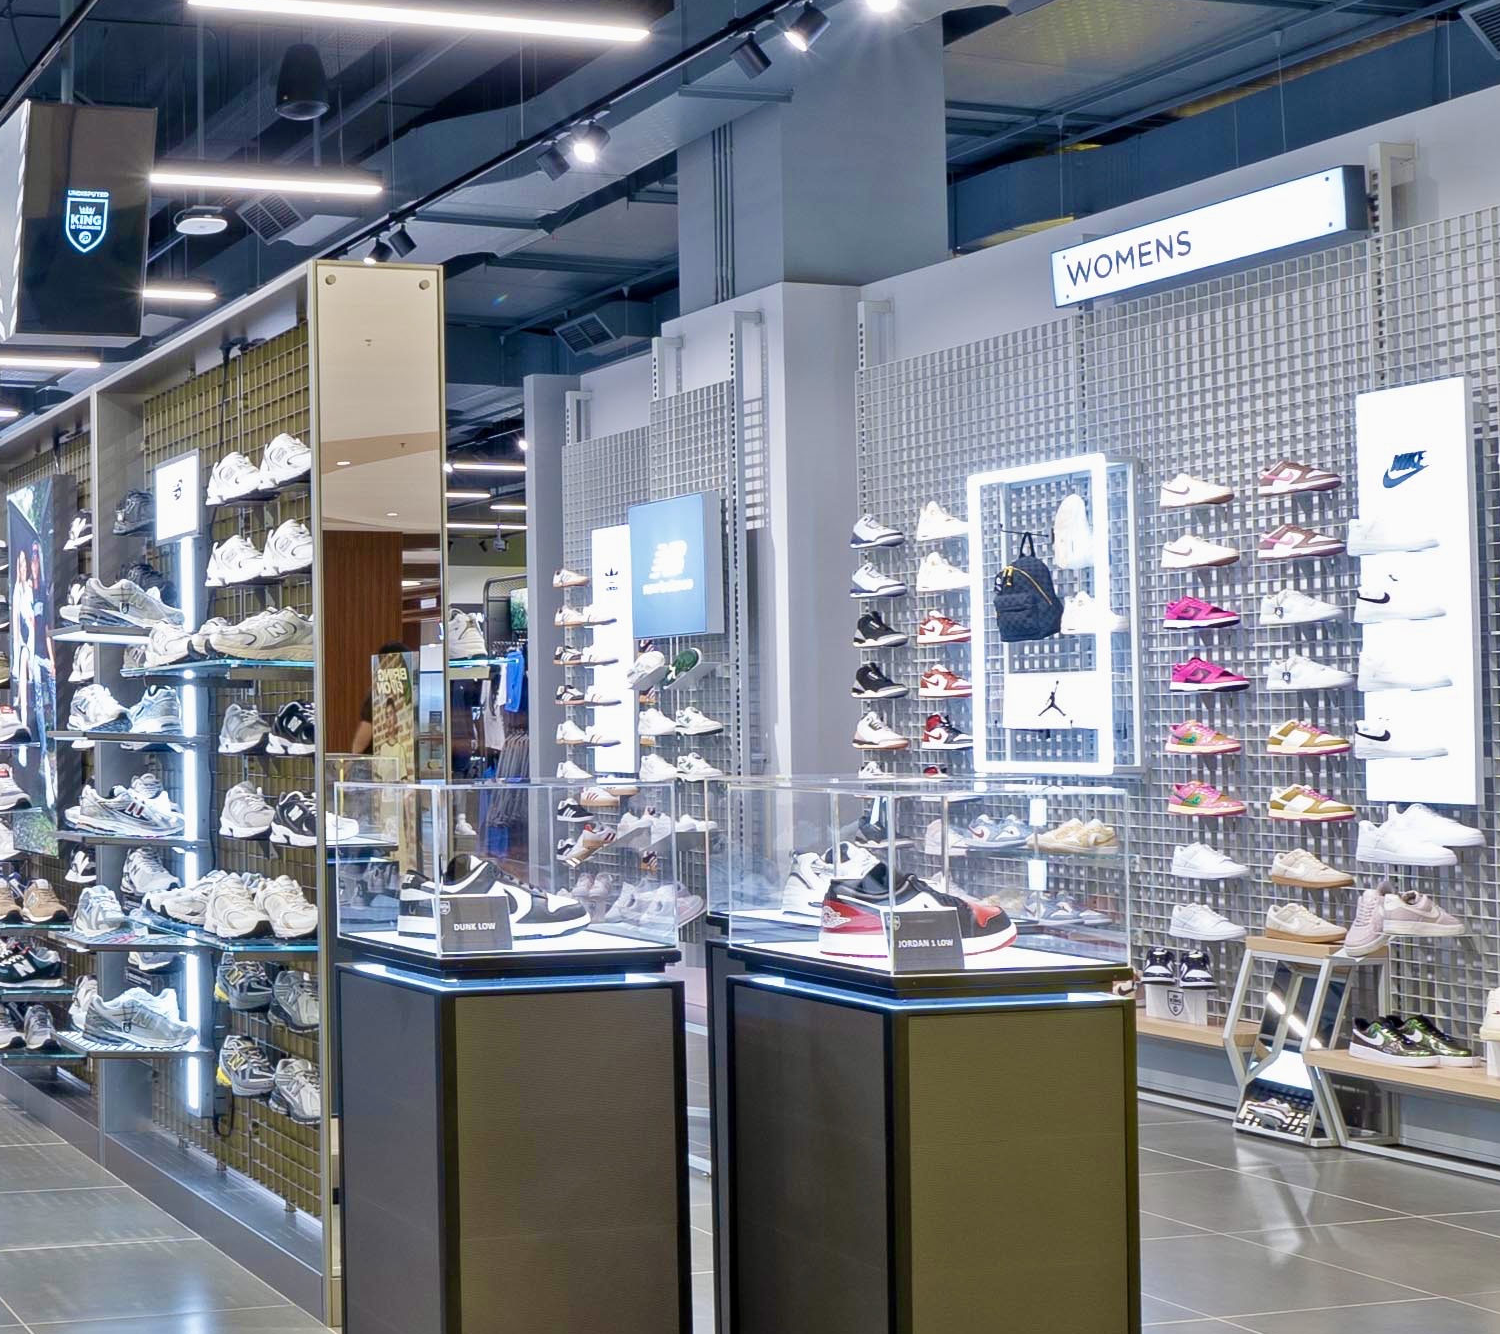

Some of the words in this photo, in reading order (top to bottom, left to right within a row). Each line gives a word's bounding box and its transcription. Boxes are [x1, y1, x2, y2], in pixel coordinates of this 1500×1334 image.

[70, 214, 102, 226] KING
[1066, 230, 1192, 287] WOMENS
[1390, 450, 1428, 472] NIKE
[453, 923, 477, 931] DUNK
[478, 922, 497, 931] LOW
[898, 939, 930, 948] JORDAN
[937, 938, 954, 947] LOW
